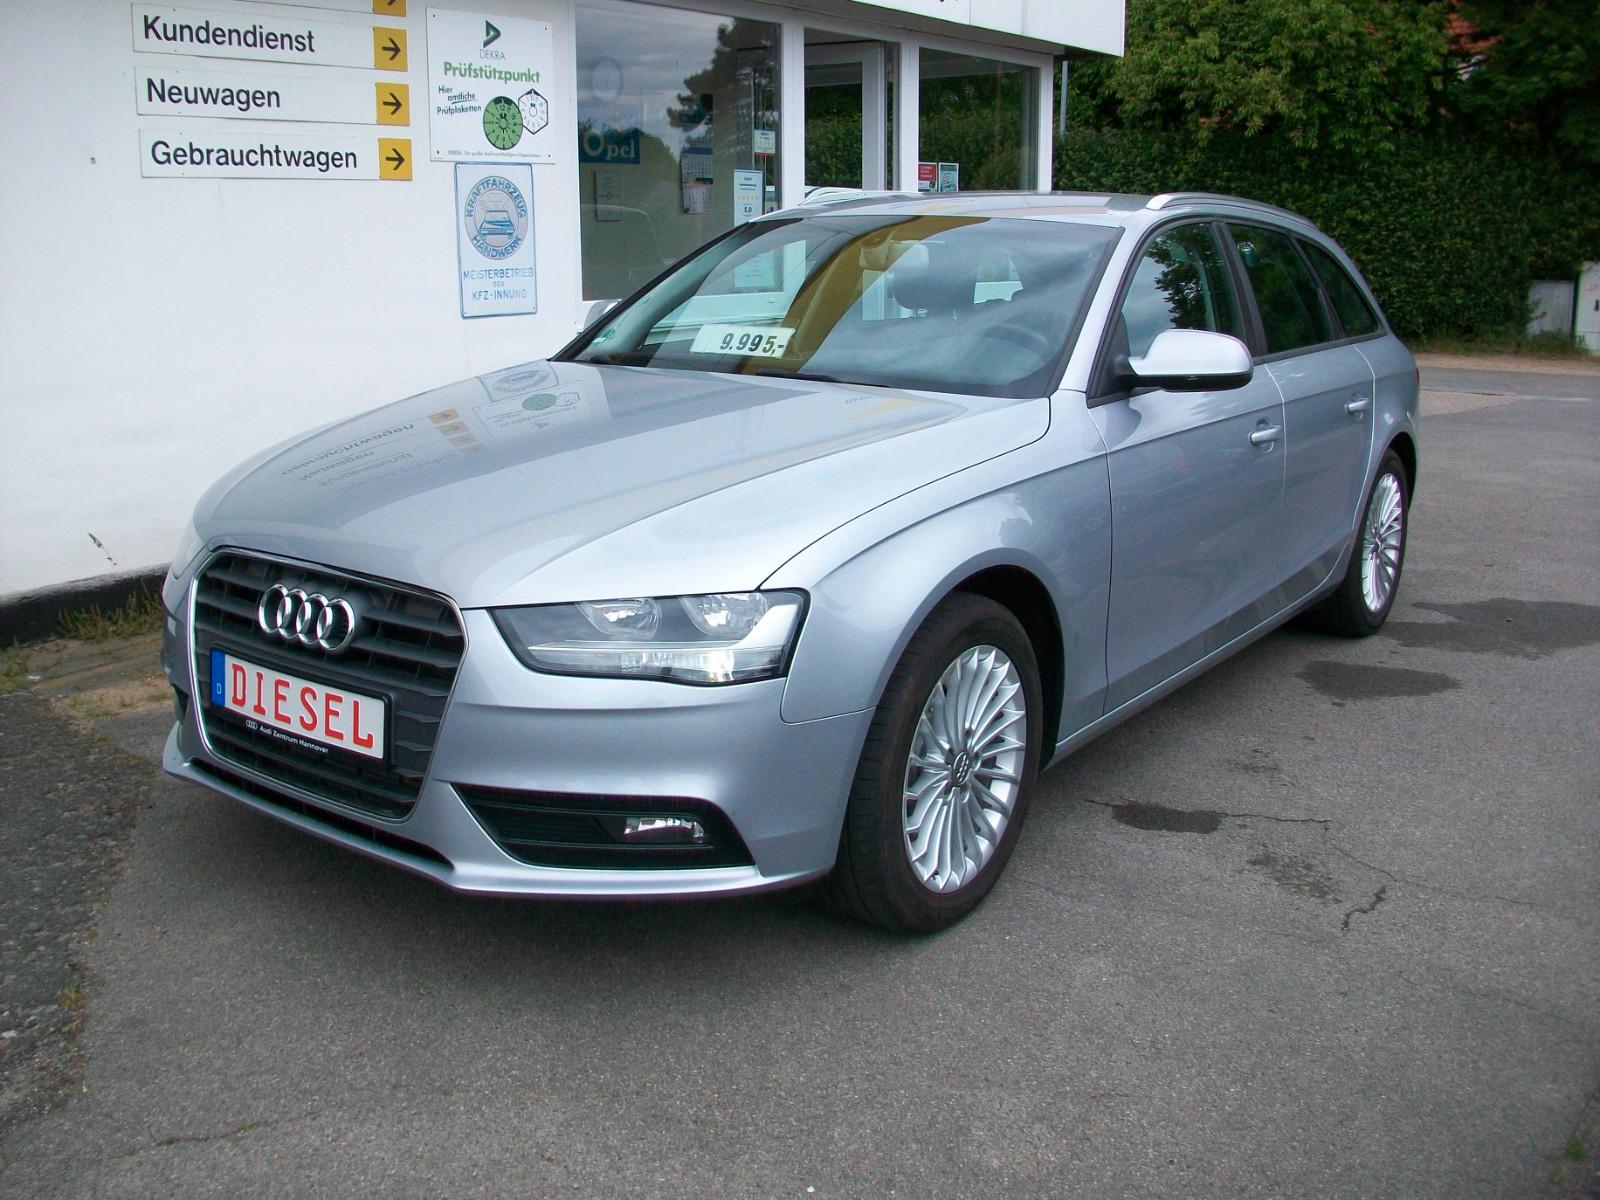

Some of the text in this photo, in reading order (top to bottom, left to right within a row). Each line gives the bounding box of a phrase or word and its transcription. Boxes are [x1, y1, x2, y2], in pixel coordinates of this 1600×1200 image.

[143, 14, 316, 53] Kundendienst
[479, 49, 506, 61] DEKRA
[443, 61, 541, 85] Prüfstützpunkt
[147, 78, 281, 112] Neuwagen
[438, 85, 453, 94] Hier
[151, 140, 358, 173] Gebrauchtwagen
[583, 128, 637, 160] Opel
[465, 177, 528, 219] KRAFTFAHRZEUG
[472, 235, 523, 258] HANDWERK
[463, 266, 534, 281] MEISTERBETRIEB
[471, 288, 528, 301] KFZ-INNUNG
[719, 332, 785, 356] 9.995,-
[216, 662, 374, 749] D DIESEL
[259, 725, 329, 753] Audi Zentrum Hannover
